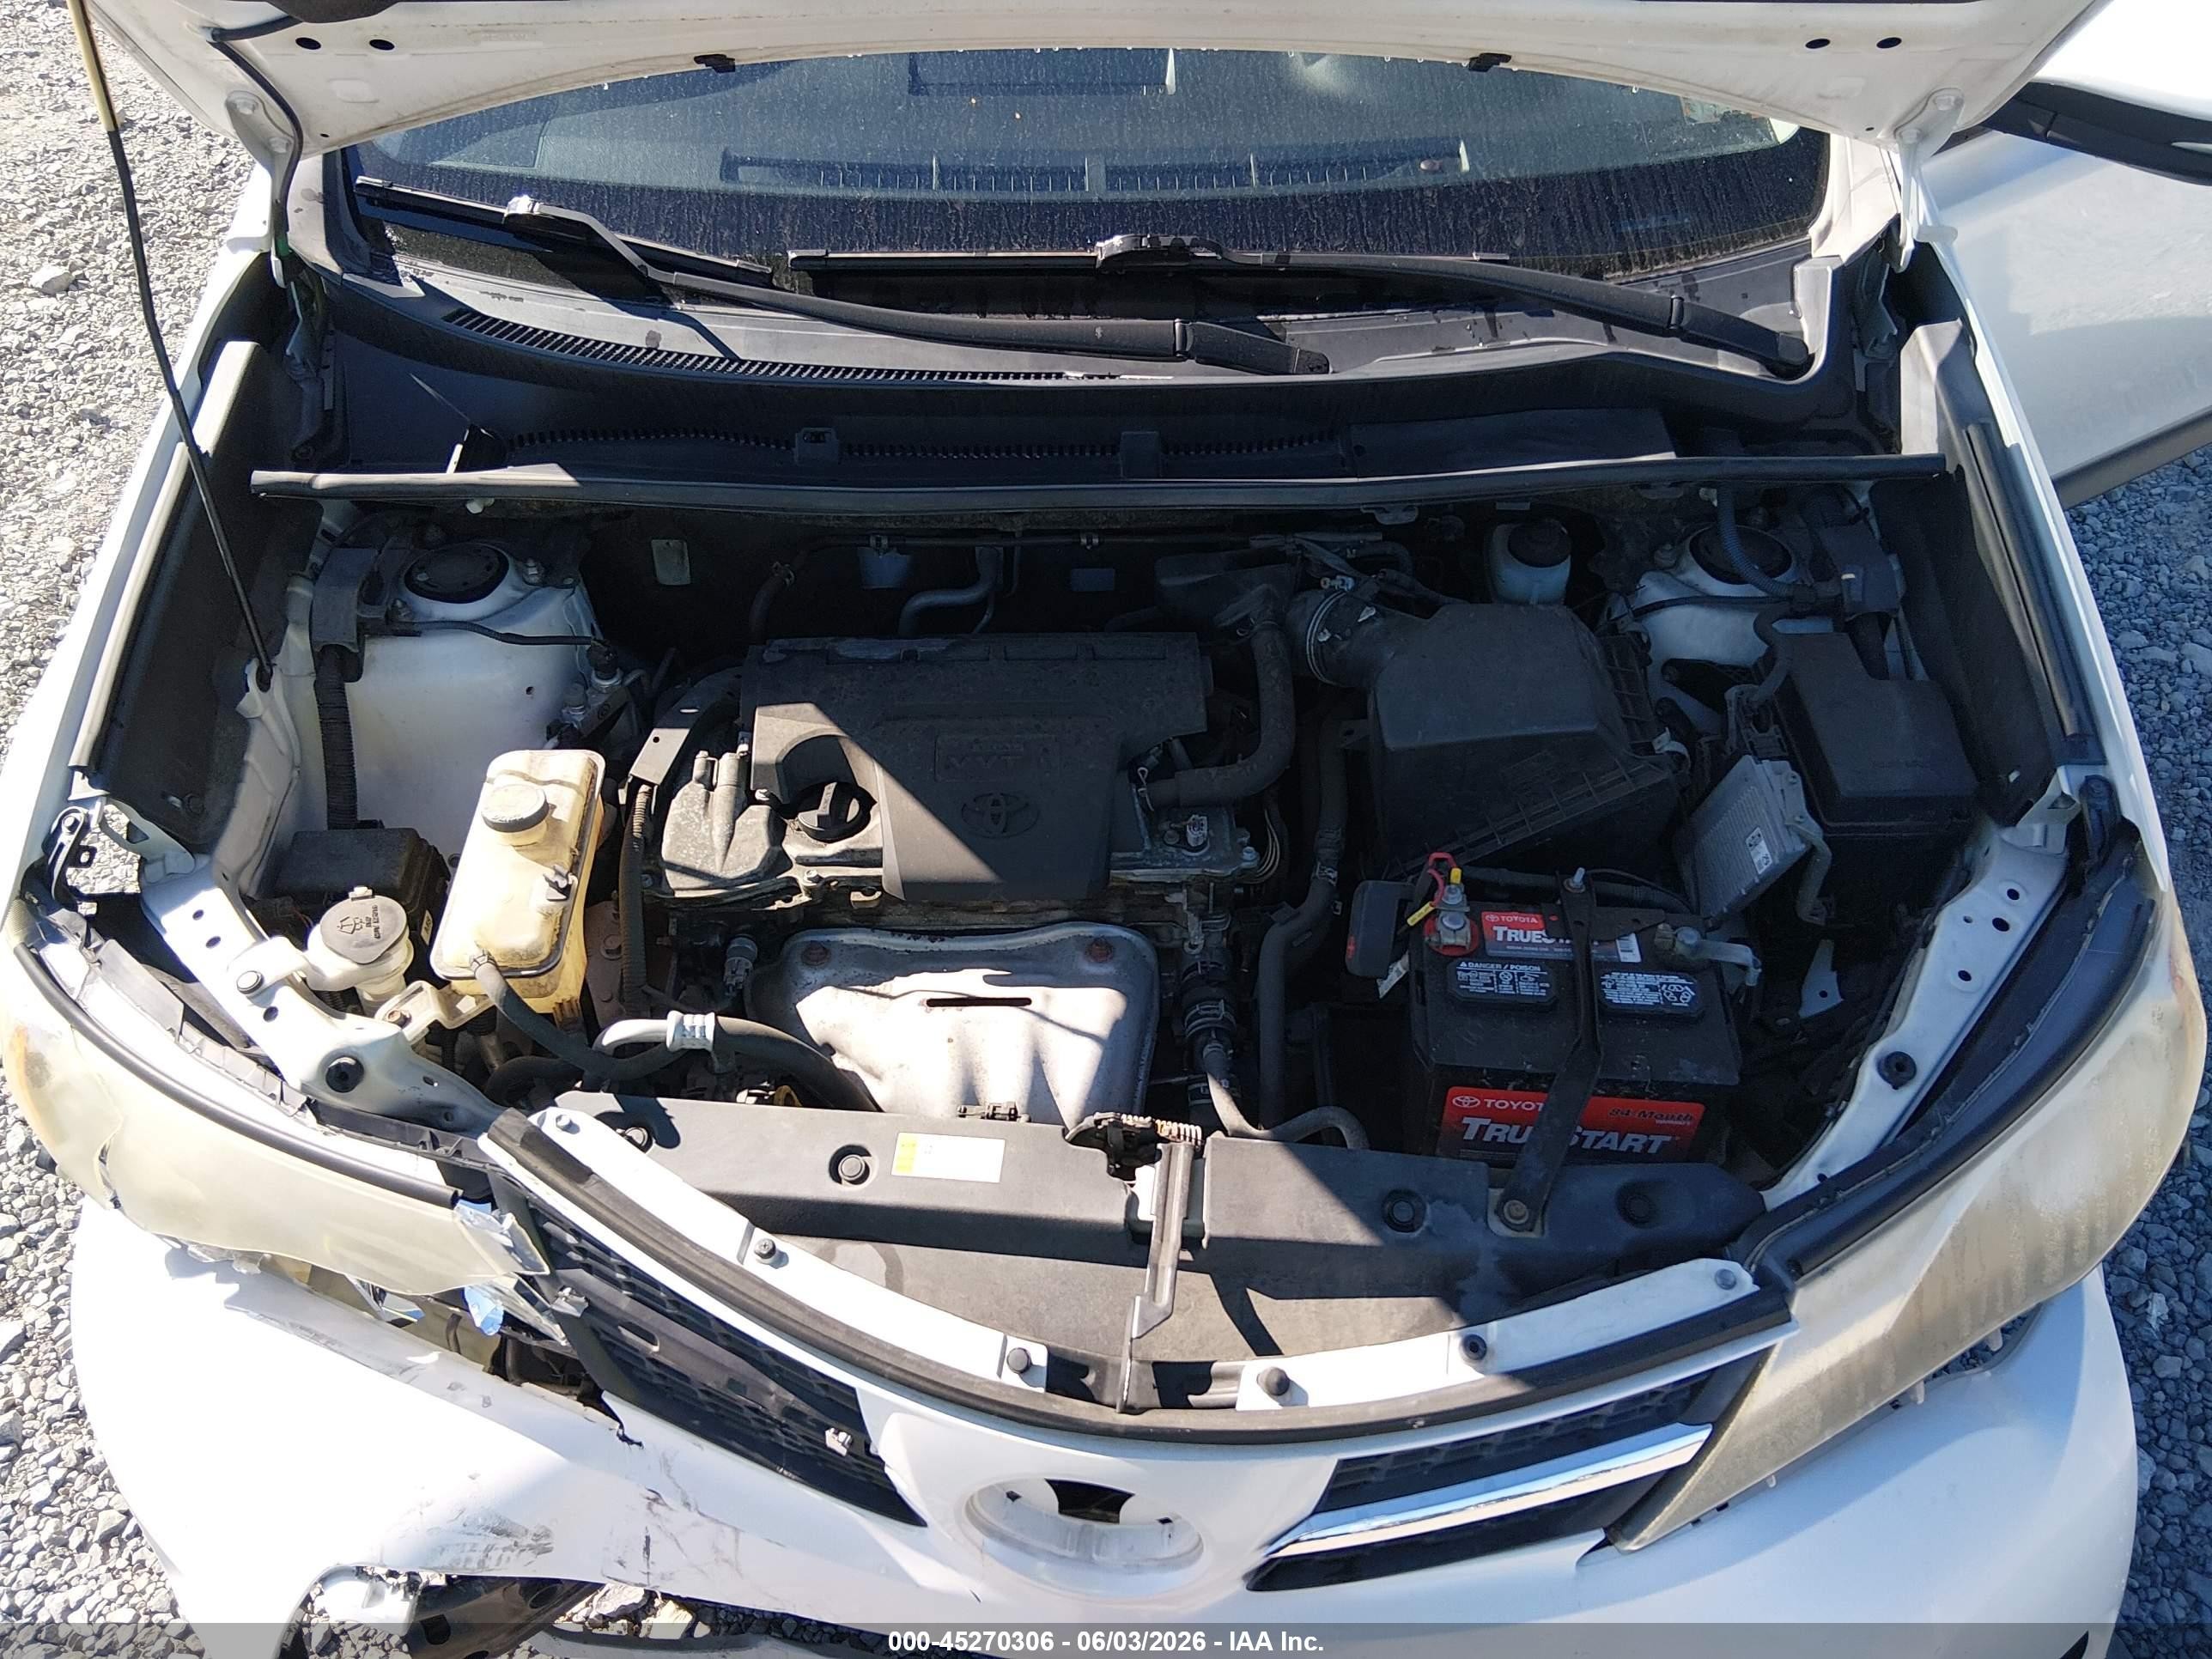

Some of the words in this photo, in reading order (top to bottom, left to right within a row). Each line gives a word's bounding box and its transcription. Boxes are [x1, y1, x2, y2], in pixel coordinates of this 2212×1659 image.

[1500, 915, 1539, 924] TOYOTA
[1510, 963, 1541, 972] POISON
[1484, 1098, 1546, 1112] TOYOT
